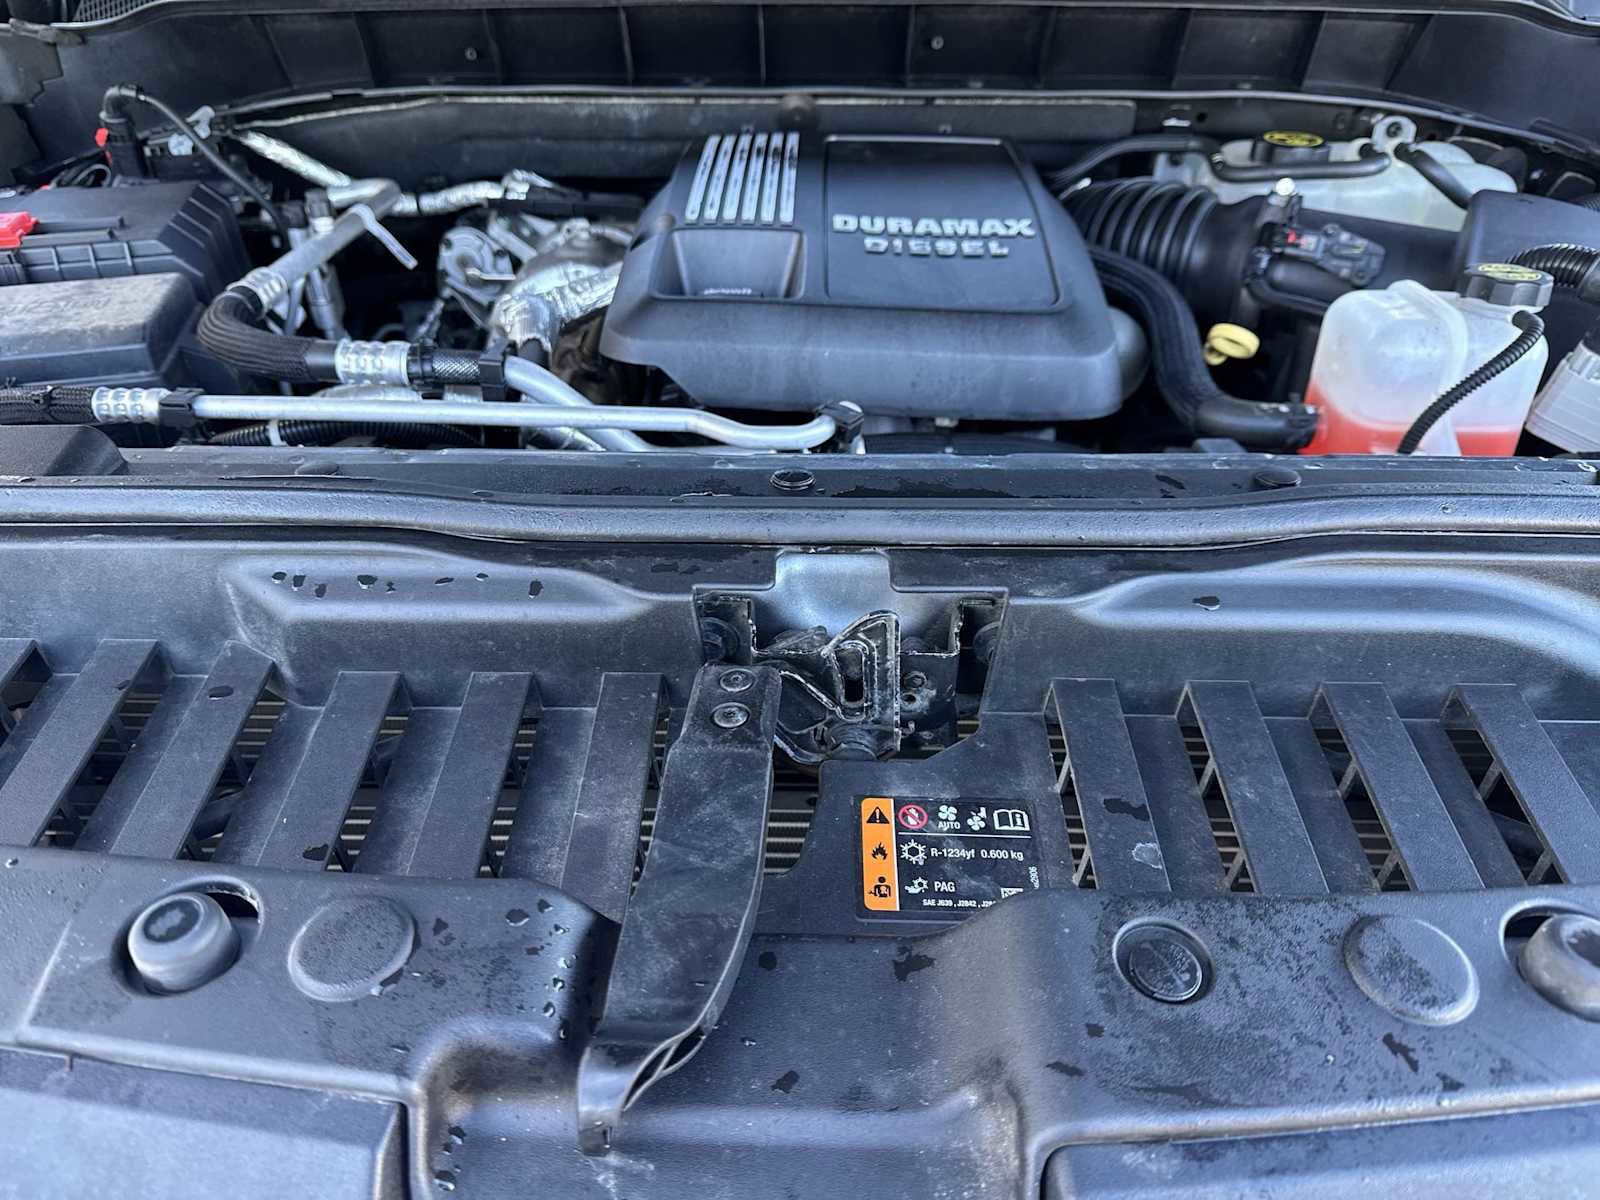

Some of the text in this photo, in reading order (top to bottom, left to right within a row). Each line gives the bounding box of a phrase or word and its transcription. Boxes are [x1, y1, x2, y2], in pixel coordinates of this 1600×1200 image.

[832, 214, 1036, 237] DURAMAX
[863, 237, 1009, 257] DIESEL
[938, 821, 961, 830] AUTO
[930, 848, 1024, 861] R-1234yf 0.600 kg
[934, 881, 955, 892] PAG
